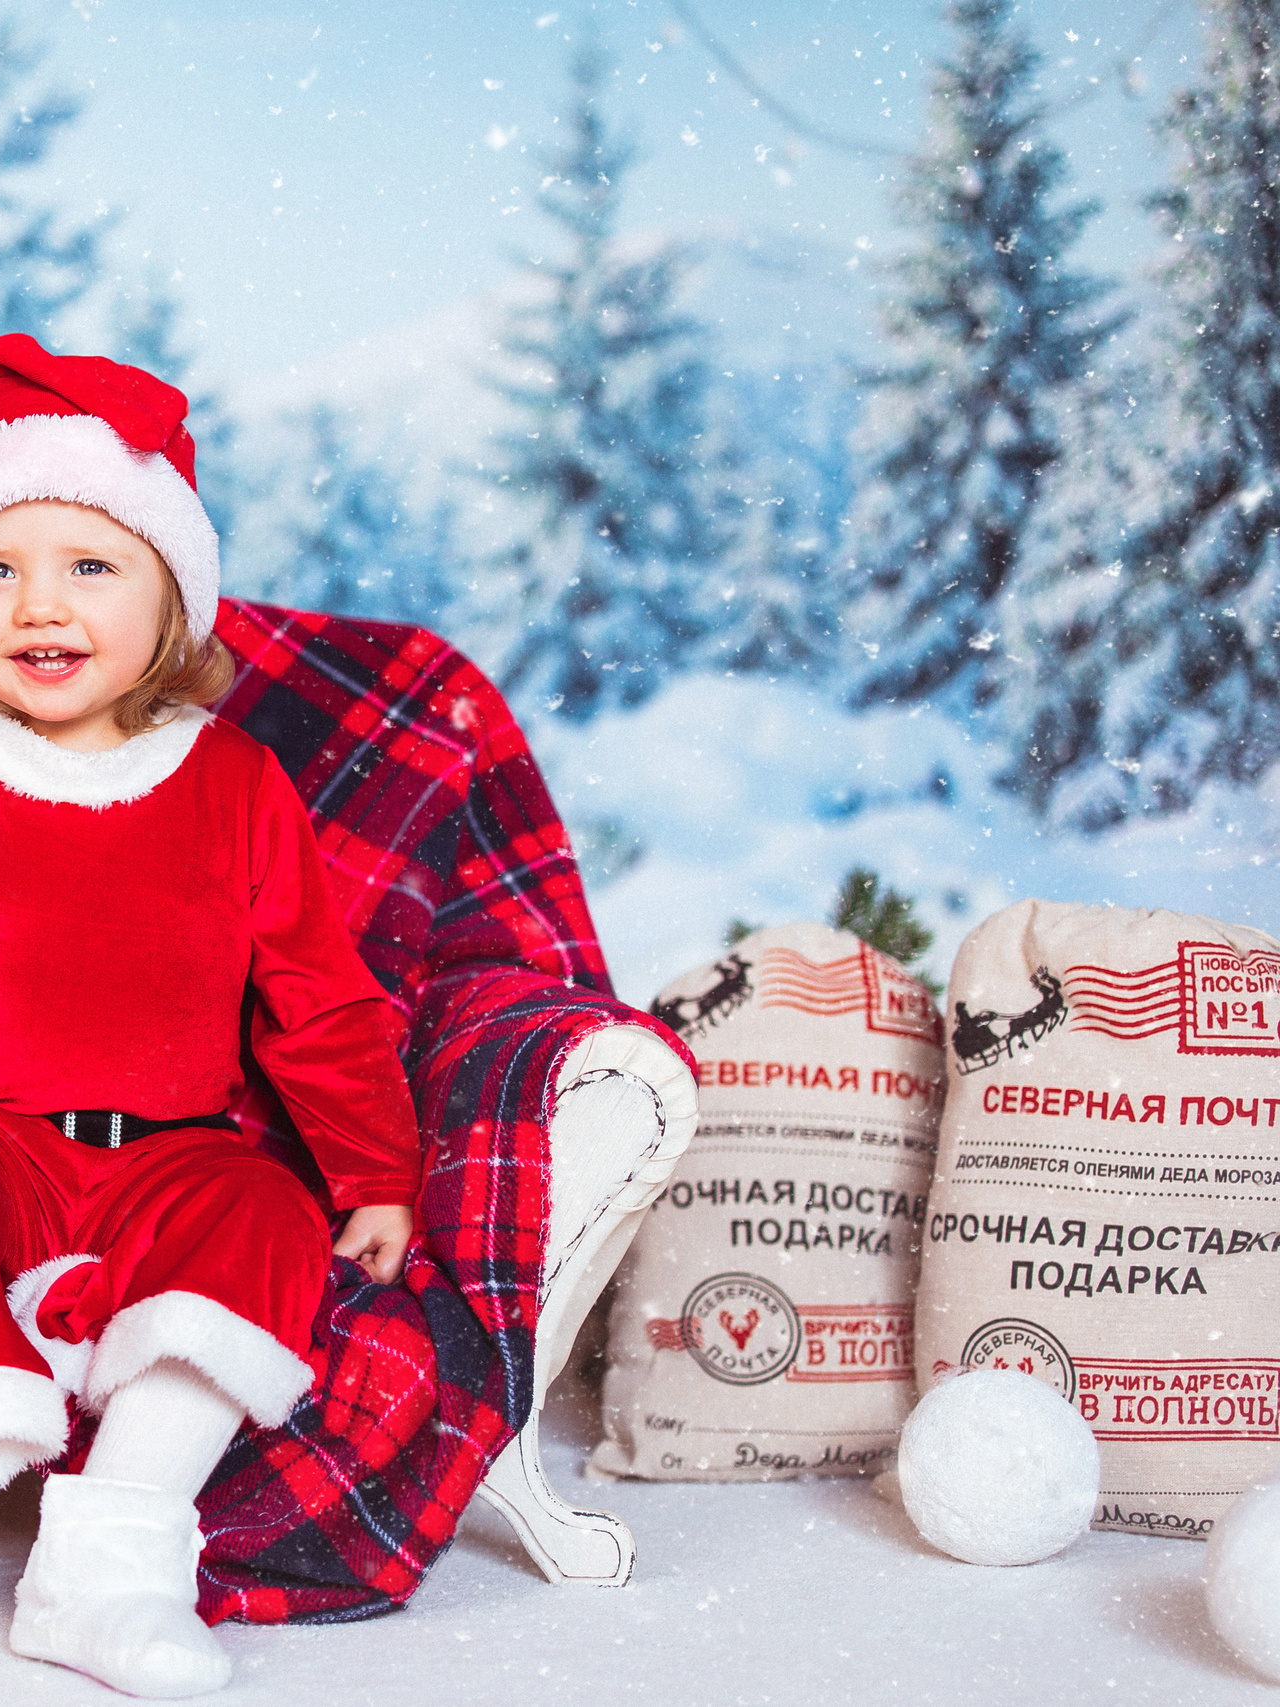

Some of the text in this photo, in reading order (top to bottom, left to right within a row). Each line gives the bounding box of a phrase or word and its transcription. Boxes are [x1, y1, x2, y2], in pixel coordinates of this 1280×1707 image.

[1200, 957, 1280, 976] НОВОГОДНЯ
[697, 1060, 932, 1104] ЕВЕРНАЯ ПОЧ
[983, 1085, 1280, 1128] СЕВЕРНАЯ ПОЧТ
[956, 1154, 1070, 1174] ДОСТАВЛЯЕТСЯ
[1073, 1161, 1156, 1181] ОЛЕНЯМИ
[1160, 1167, 1209, 1184] ДЕДА
[652, 1180, 928, 1221] ОЧНАЯ ДОСТАВ
[730, 1219, 893, 1256] ПОДАРКА
[930, 1213, 1087, 1248] СРОЧНАЯ
[1010, 1261, 1208, 1298] ПОДАРКА
[697, 1286, 780, 1319] СЕВЕРНАЯ
[705, 1344, 781, 1371] ПОЧТА
[806, 1339, 826, 1367] В
[973, 1332, 1057, 1366] СЕВЕРНАЯ
[1078, 1373, 1276, 1393] ВРУЧИТЬ АДРЕСАТУ
[1079, 1394, 1275, 1427] В ПОЛНОЧЬ
[733, 1442, 807, 1470] Деда
